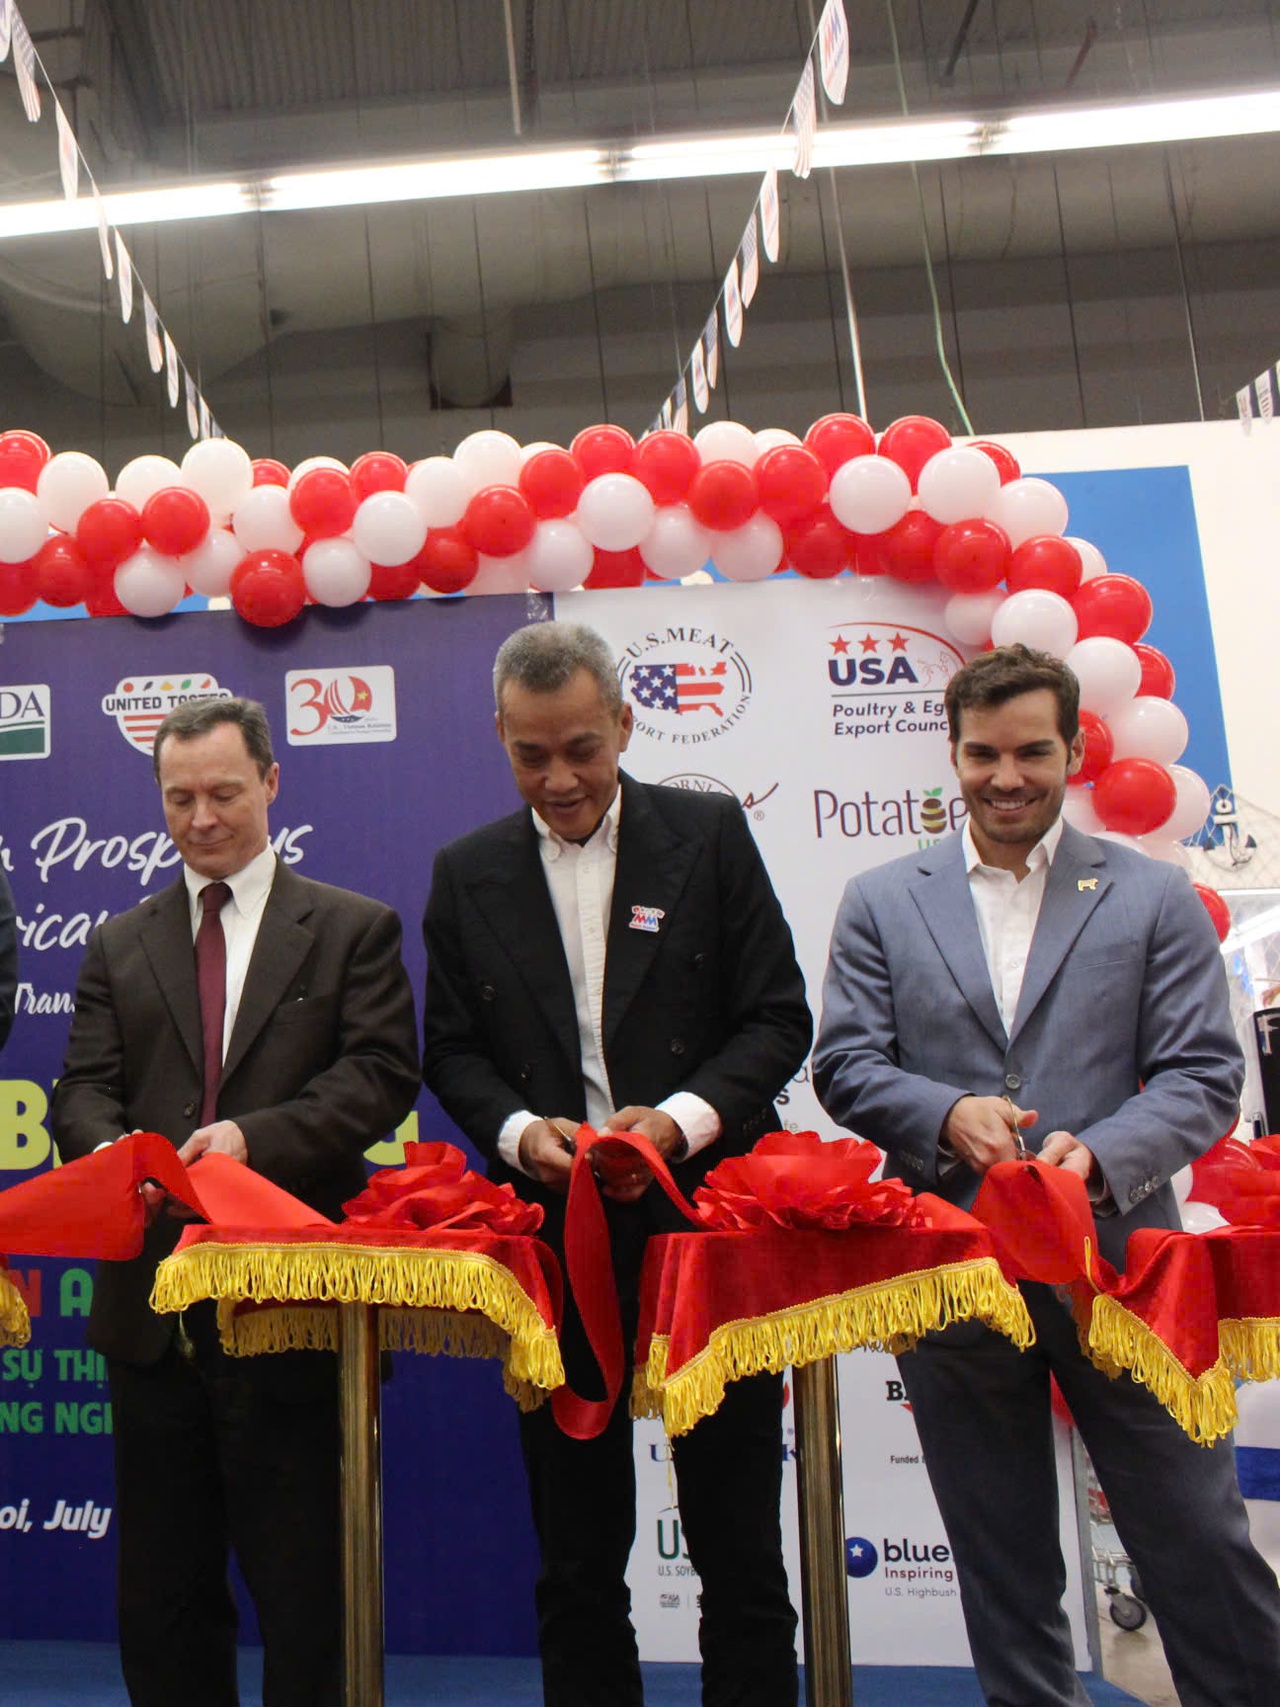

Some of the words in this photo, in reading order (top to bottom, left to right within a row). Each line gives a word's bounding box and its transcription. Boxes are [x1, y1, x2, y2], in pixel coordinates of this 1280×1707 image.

[828, 656, 919, 686] USA
[105, 697, 162, 712] UNITED
[833, 702, 897, 718] Poultry
[903, 701, 916, 714] &
[923, 700, 945, 716] Eg
[672, 695, 751, 744] FEDERATION
[834, 720, 890, 738] Export
[895, 719, 948, 733] Counc
[54, 1349, 109, 1389] THỊ
[43, 1500, 112, 1539] July
[883, 1538, 950, 1562] blue
[884, 1567, 953, 1582] Inspiring
[884, 1587, 904, 1597] U.S.
[907, 1586, 957, 1599] Highbush
